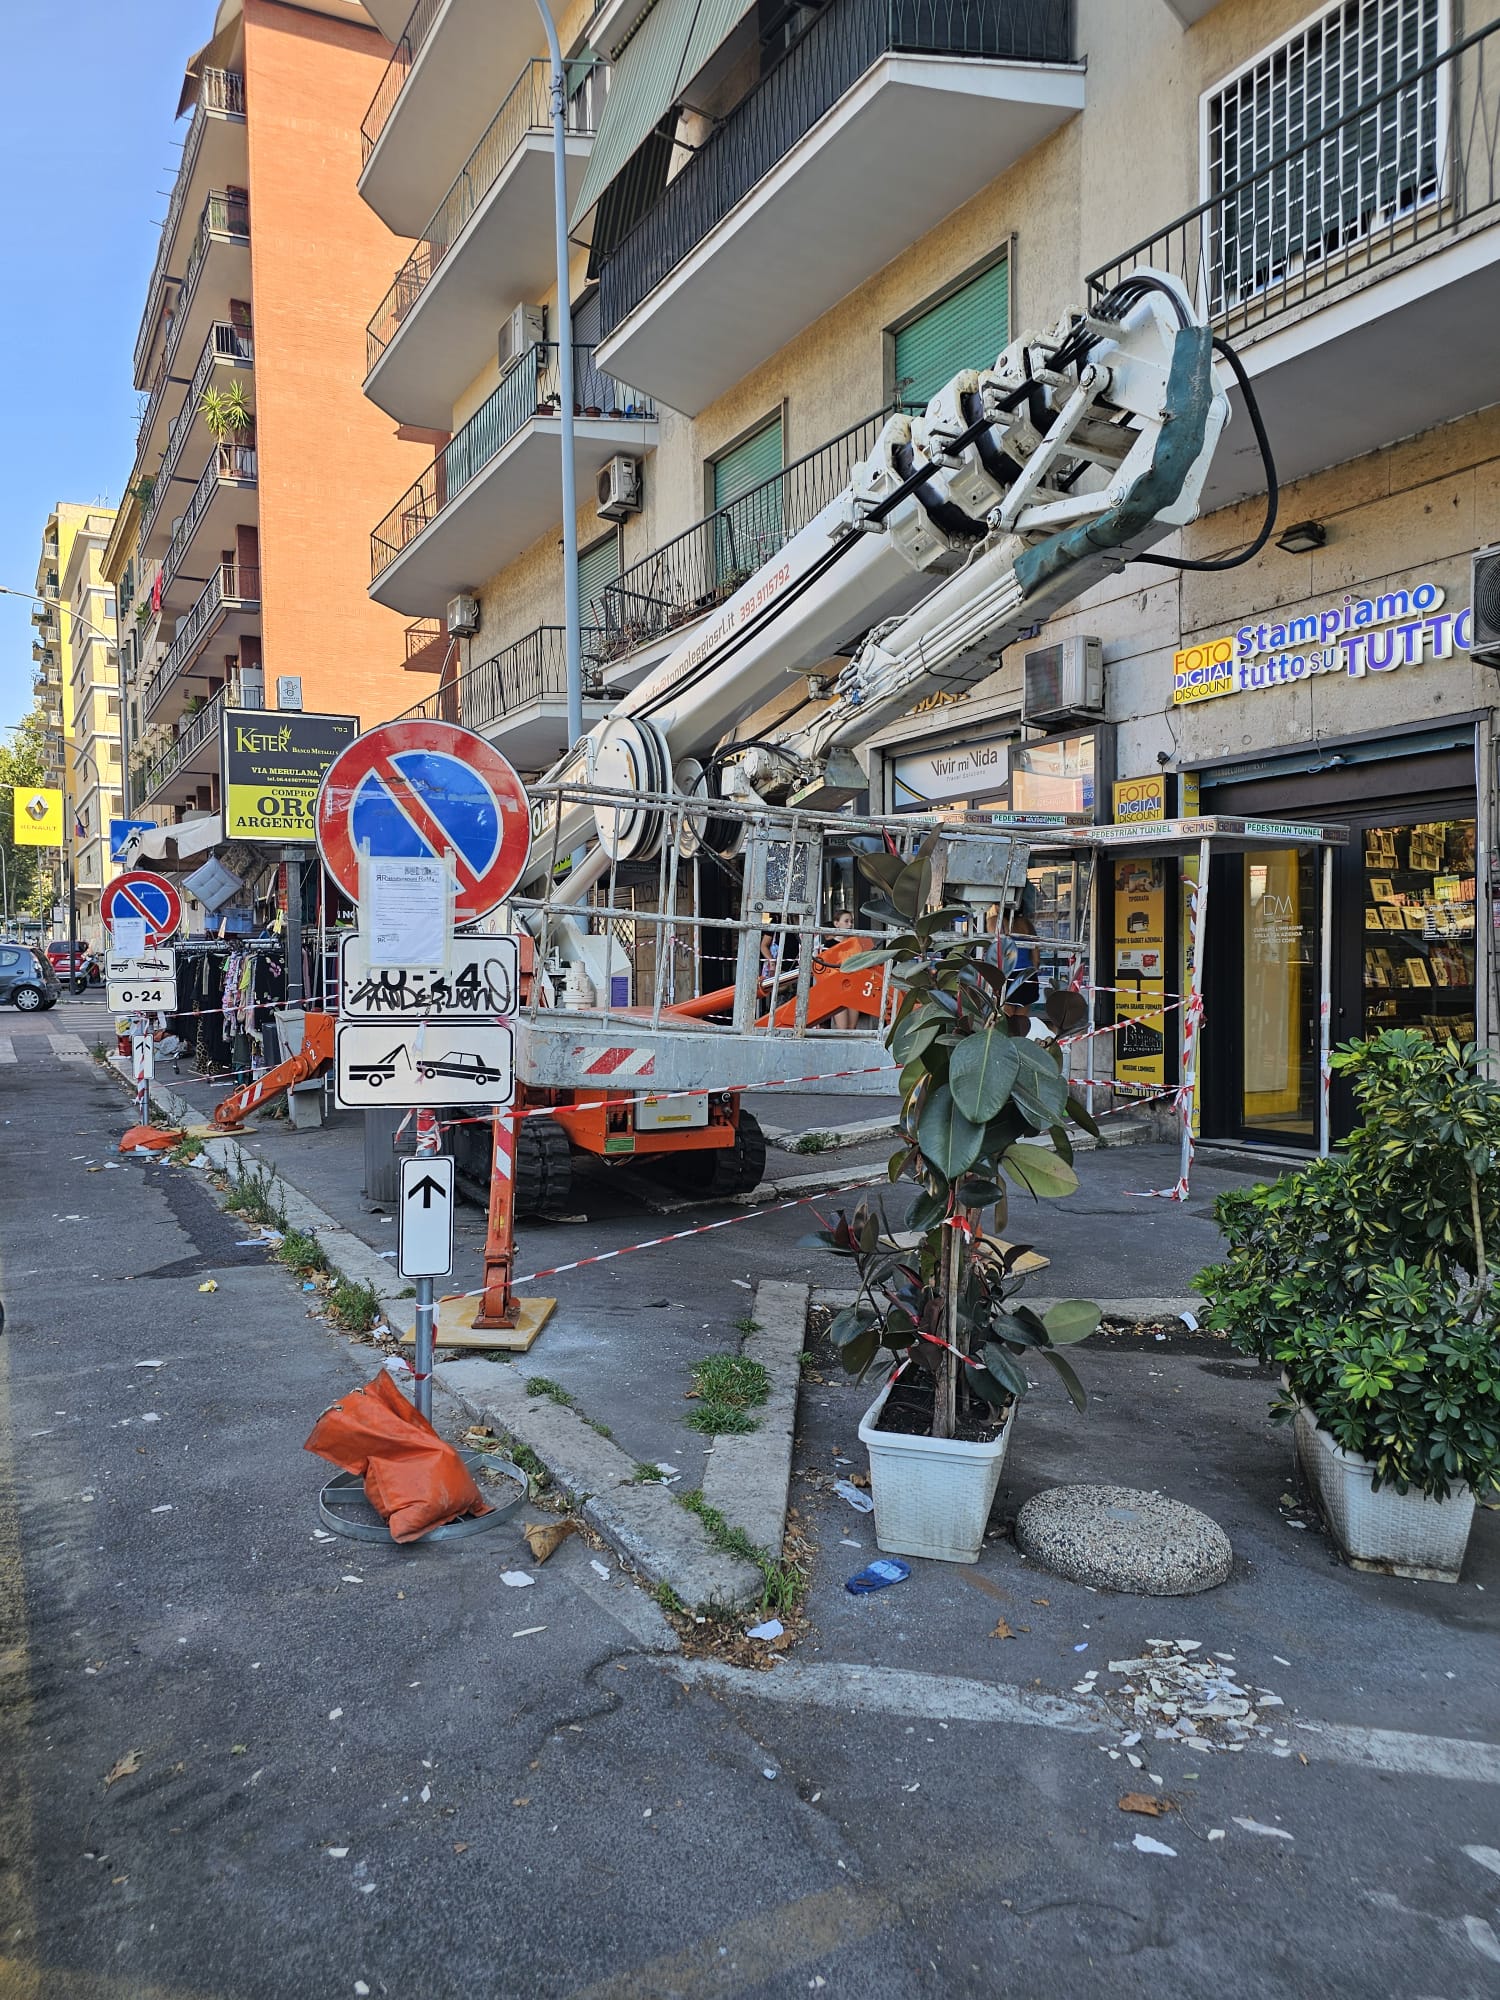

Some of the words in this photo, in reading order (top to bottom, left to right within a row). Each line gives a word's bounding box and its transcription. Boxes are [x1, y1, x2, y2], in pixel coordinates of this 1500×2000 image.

[740, 563, 791, 622] 393.9115792
[1236, 583, 1436, 657] Stampiamo
[1175, 642, 1232, 675] FOTO
[1175, 661, 1232, 690] DIGITAL
[1239, 653, 1305, 689] tutto
[1175, 677, 1231, 701] DISCOUNT
[235, 727, 288, 753] KETER
[931, 757, 956, 777] Vivir
[958, 757, 969, 771] mi
[969, 748, 998, 767] Vida
[272, 789, 314, 797] COMPRO
[1119, 783, 1160, 803] FOTO
[1119, 797, 1161, 815] DIGITAL
[1119, 810, 1160, 823] DISCOUNT
[1092, 827, 1138, 838] PEDESTRIAN
[1140, 825, 1171, 835] TUNNEL
[1247, 824, 1292, 834] PEDESTRIAN
[1294, 828, 1322, 836] TUNNEL
[122, 990, 162, 1003] 0-24
[863, 982, 872, 996] 3
